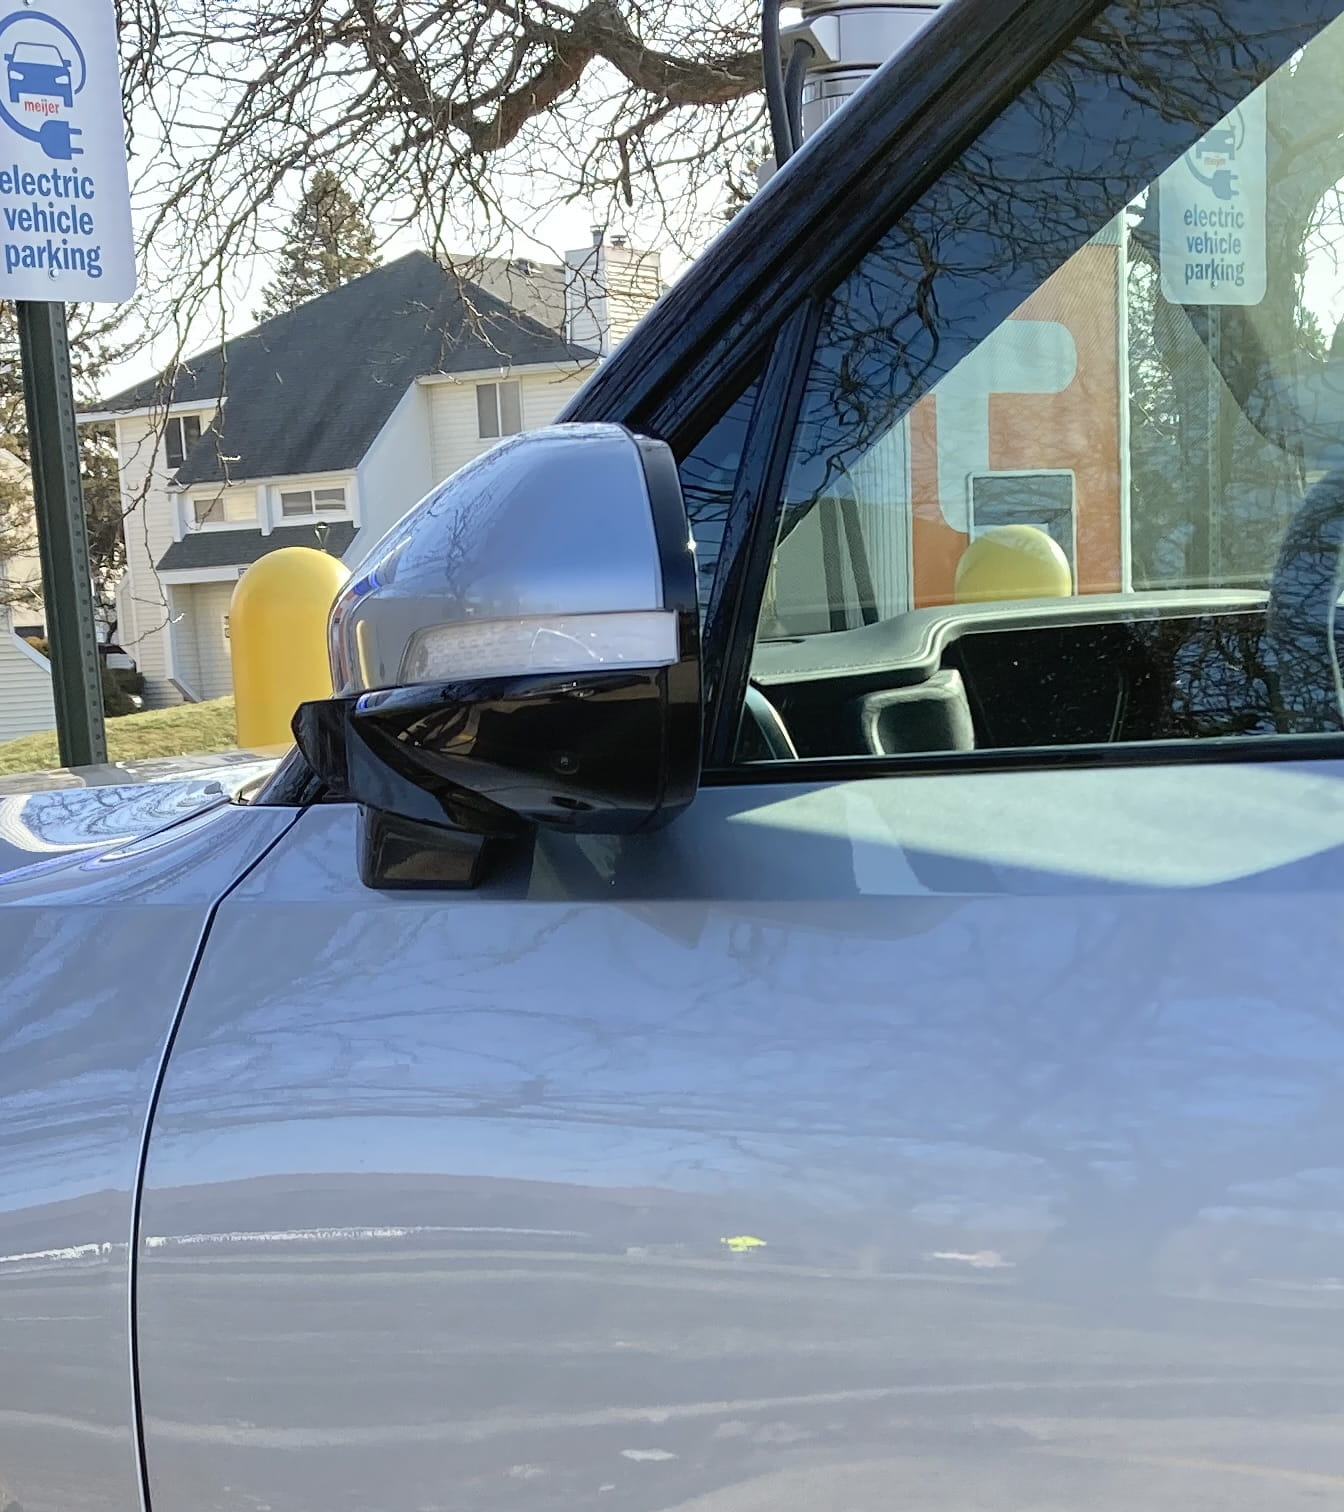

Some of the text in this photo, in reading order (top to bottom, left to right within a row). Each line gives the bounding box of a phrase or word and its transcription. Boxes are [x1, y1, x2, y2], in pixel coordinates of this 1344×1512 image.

[23, 99, 60, 116] meijer
[3, 201, 94, 236] vehicle
[1183, 203, 1245, 229] electric
[1186, 230, 1241, 255] vehicle
[4, 238, 104, 279] parking
[1184, 257, 1246, 287] parking
